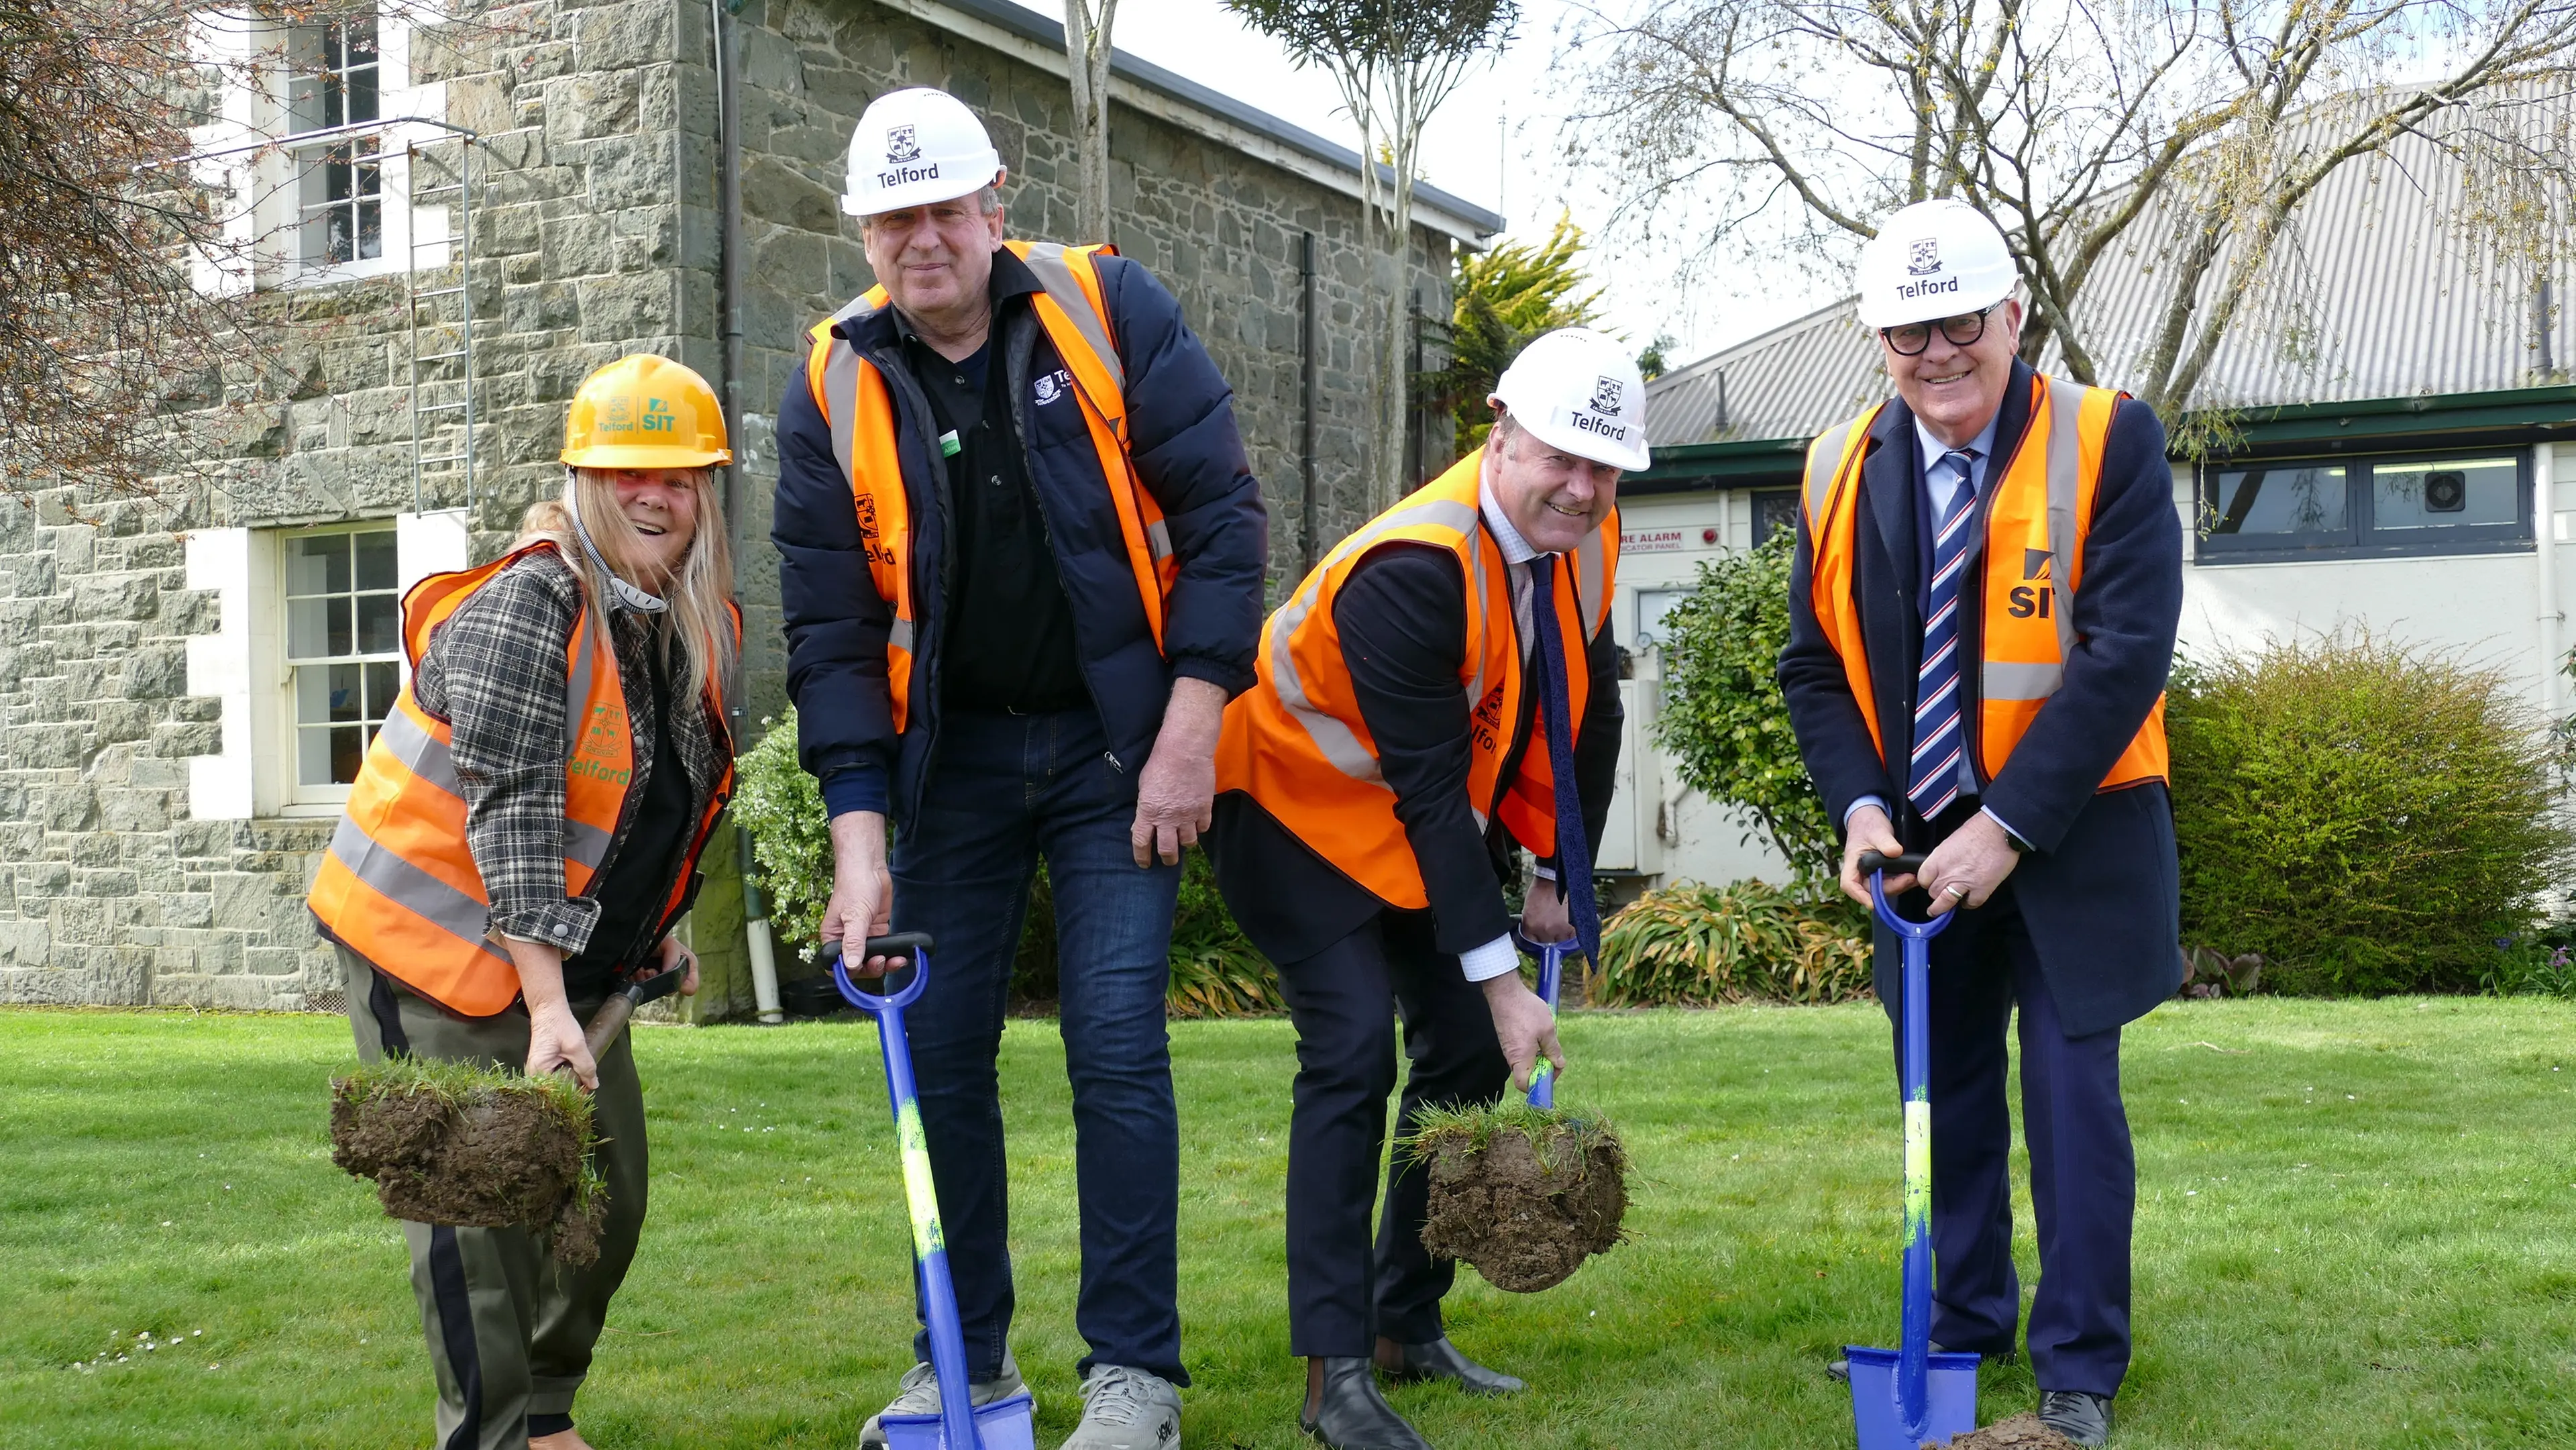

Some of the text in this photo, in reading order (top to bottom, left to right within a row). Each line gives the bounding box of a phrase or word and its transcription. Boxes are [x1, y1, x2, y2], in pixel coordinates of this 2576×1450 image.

[877, 163, 938, 189] Telford
[1896, 276, 1958, 301] Telford
[598, 421, 633, 432] Telford
[642, 414, 676, 431] SIT
[1572, 411, 1626, 442] Telford
[1640, 532, 1681, 542] ALARM
[2008, 586, 2056, 619] SI
